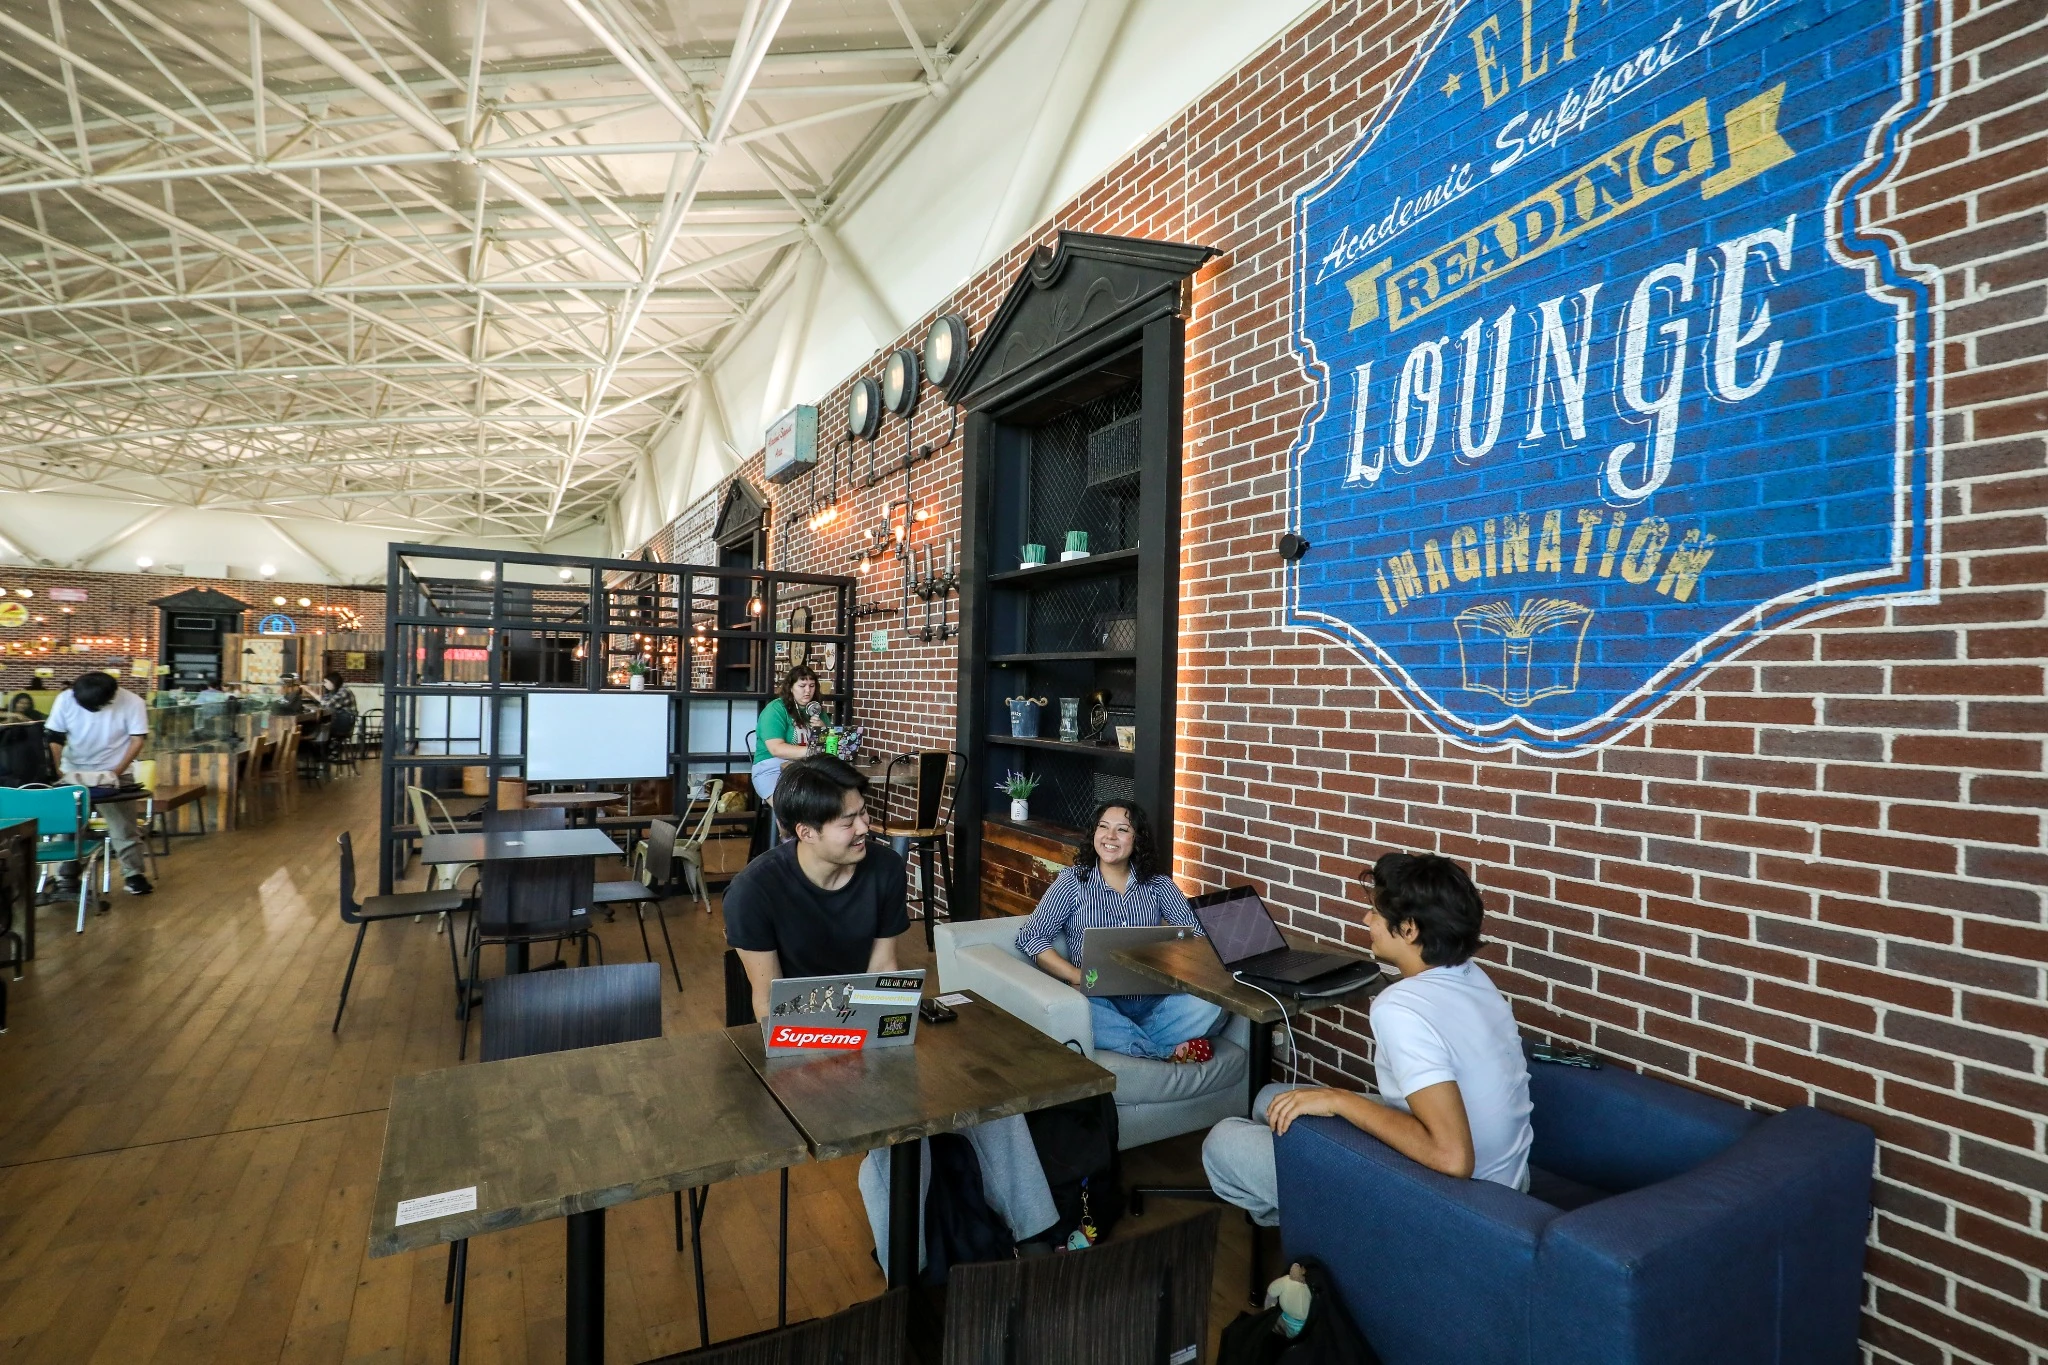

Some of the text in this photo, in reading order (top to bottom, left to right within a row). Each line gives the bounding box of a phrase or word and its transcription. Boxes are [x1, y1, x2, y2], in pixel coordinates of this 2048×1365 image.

[1316, 16, 1682, 285] Academic Support
[1395, 118, 1696, 319] READING
[1341, 215, 1797, 506] LOUNGE
[1375, 509, 1717, 615] IMAGINATION
[776, 1028, 862, 1046] Supreme
